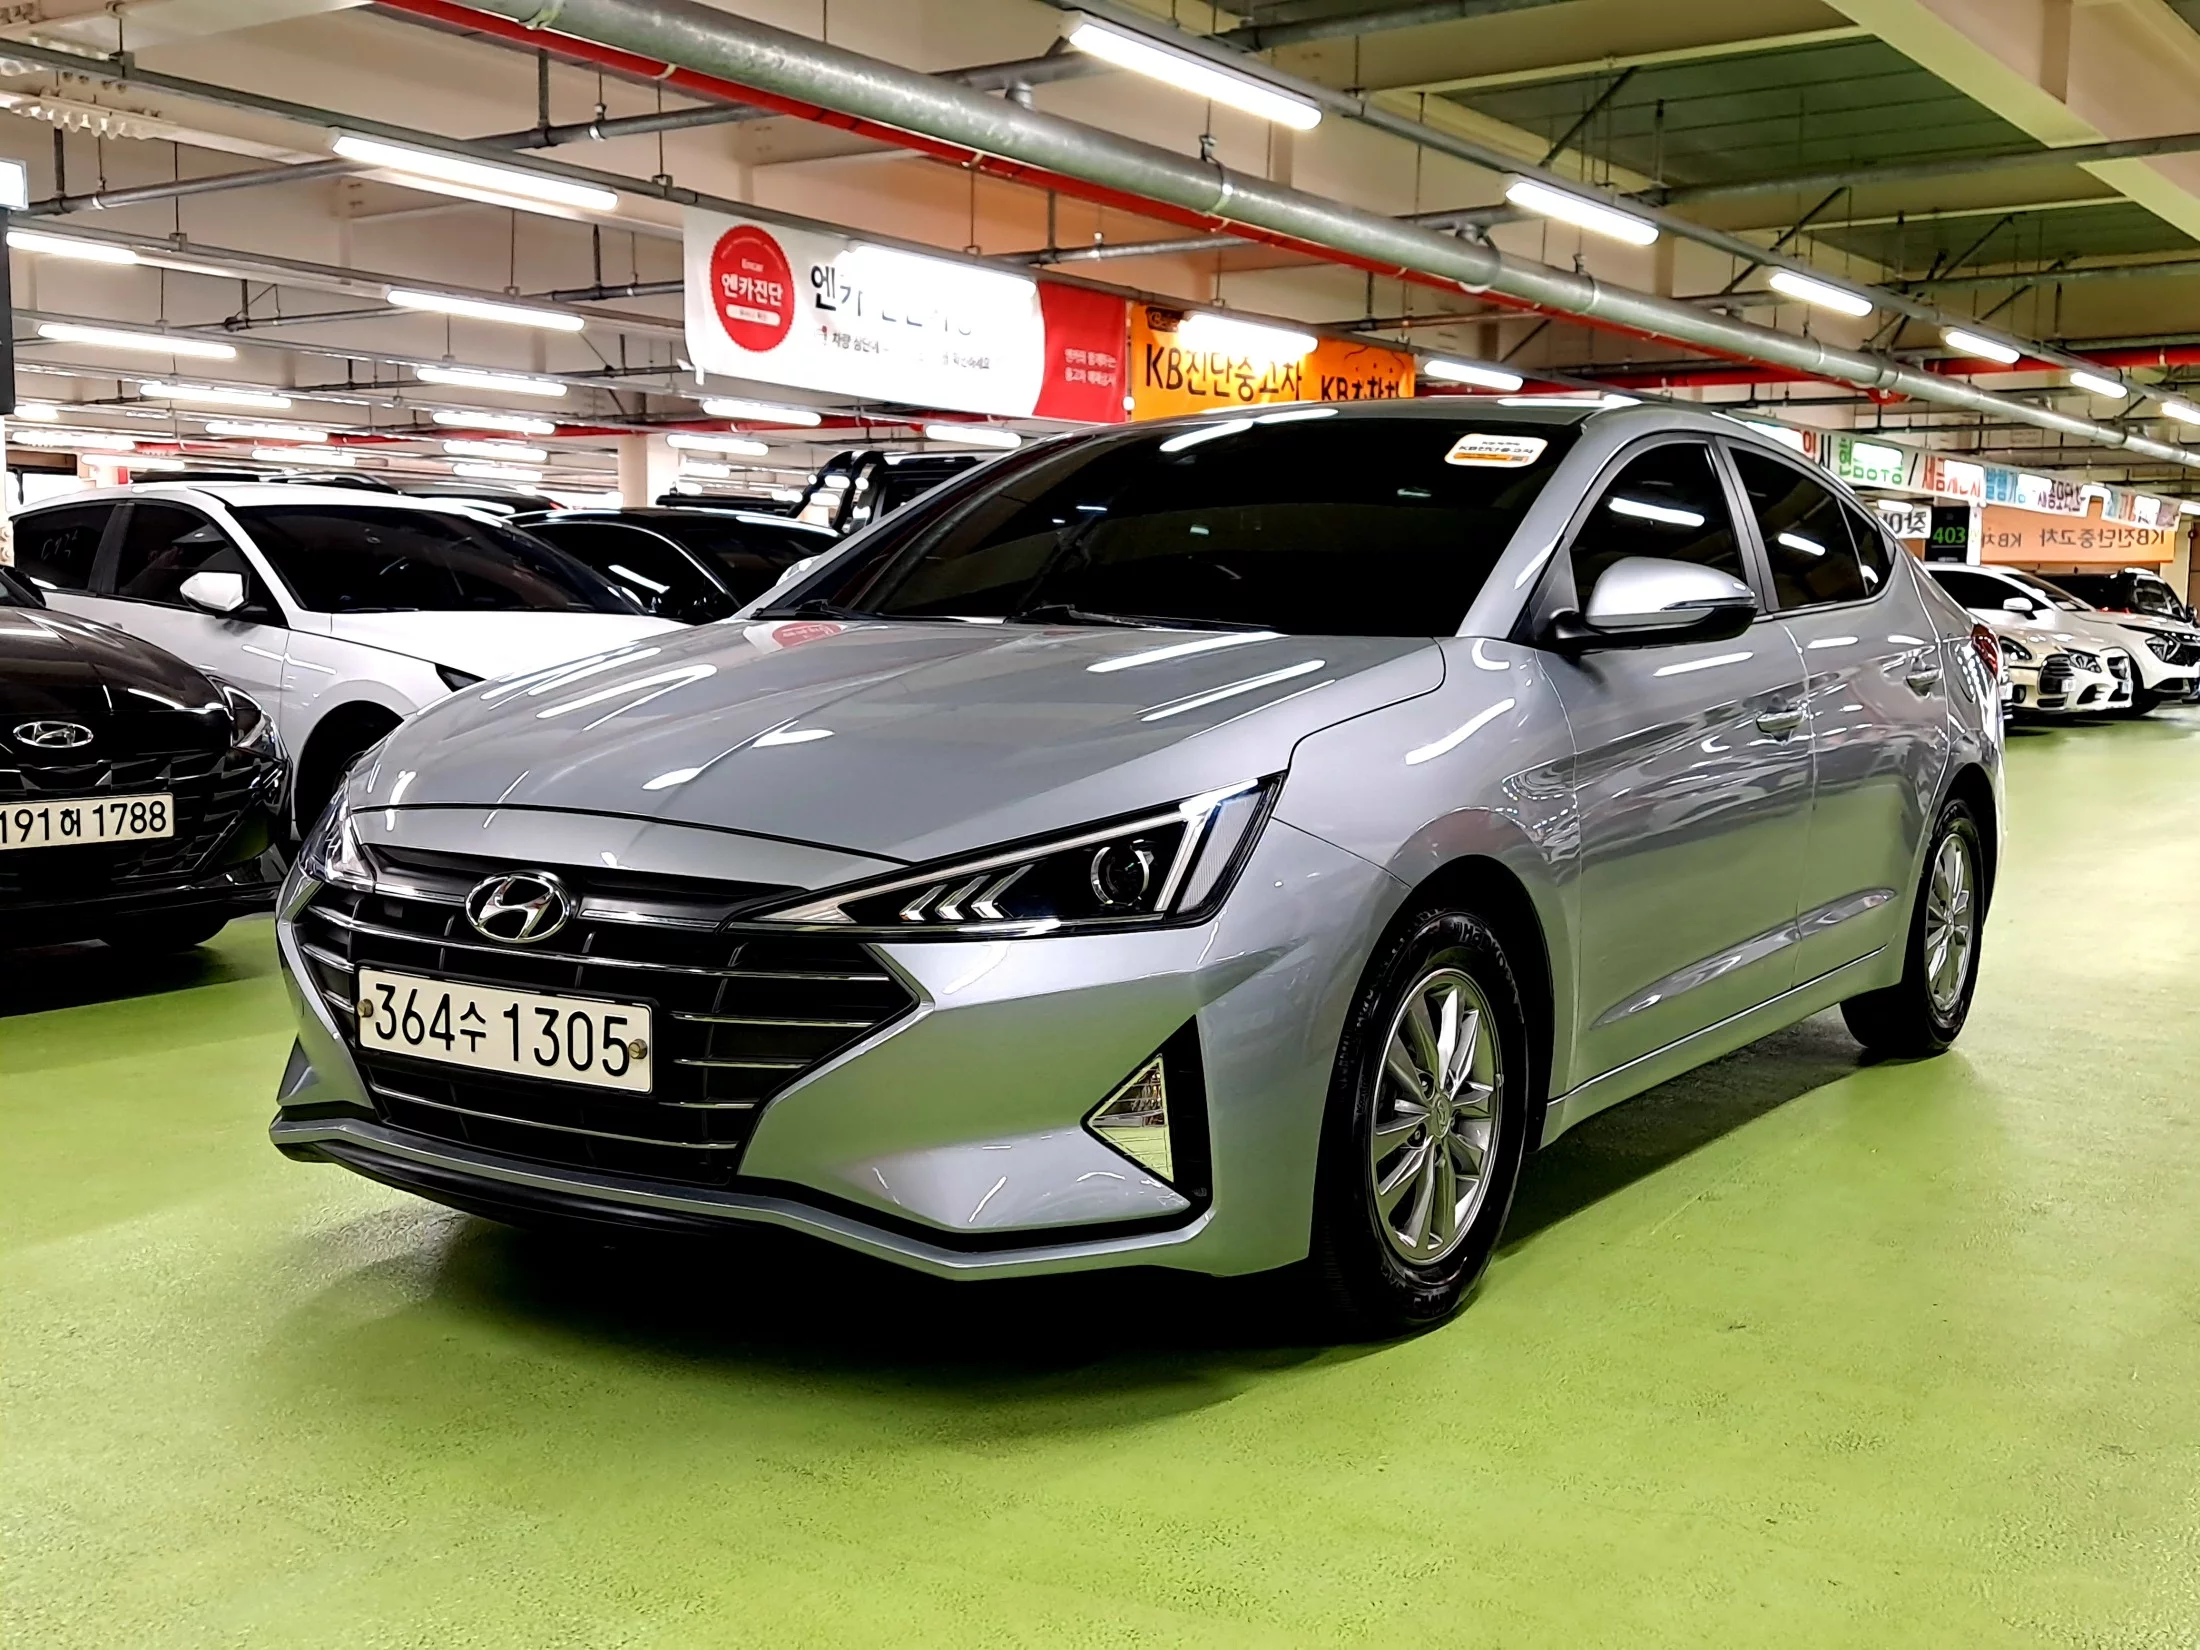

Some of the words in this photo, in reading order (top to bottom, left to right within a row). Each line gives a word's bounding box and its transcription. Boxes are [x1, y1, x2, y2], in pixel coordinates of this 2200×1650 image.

[721, 273, 784, 307] 엔카진단
[1932, 526, 1966, 544] 403
[0, 807, 82, 844] 191허
[93, 800, 167, 836] 1788
[374, 983, 487, 1053] 364수
[503, 1002, 630, 1077] 1305
